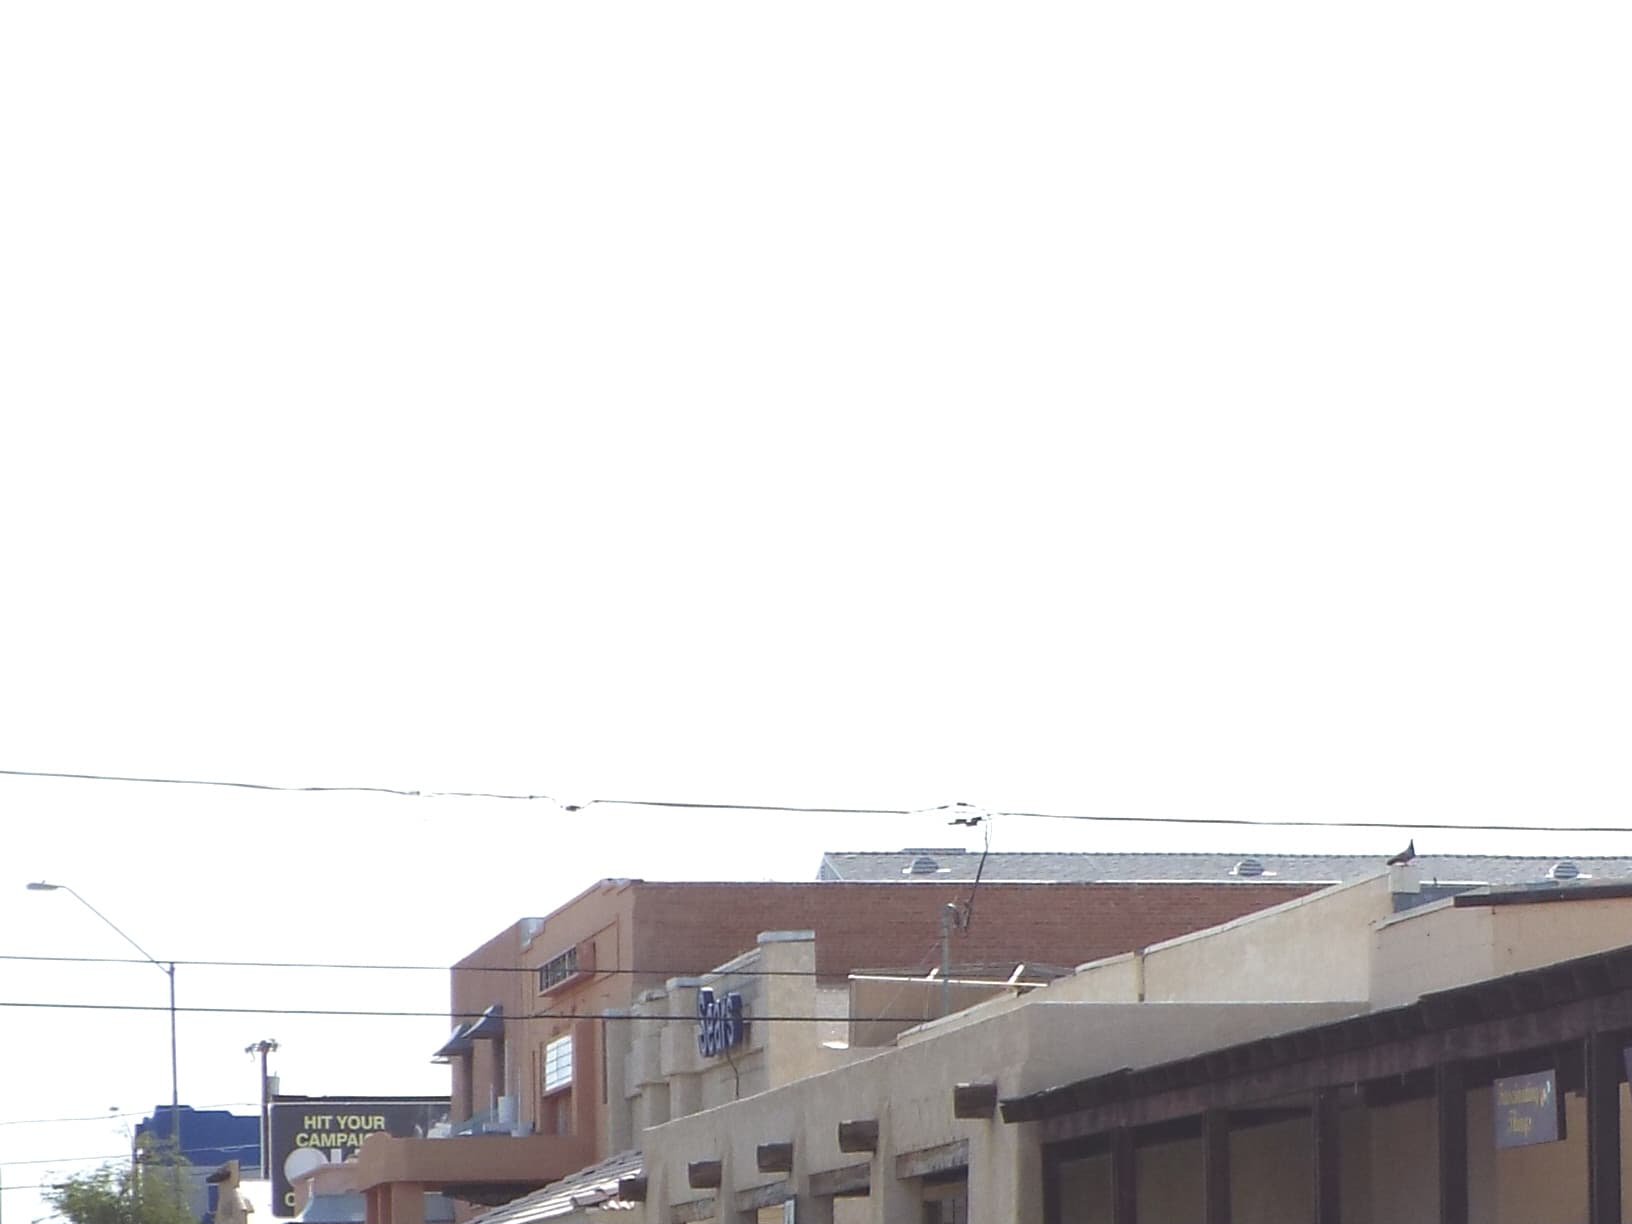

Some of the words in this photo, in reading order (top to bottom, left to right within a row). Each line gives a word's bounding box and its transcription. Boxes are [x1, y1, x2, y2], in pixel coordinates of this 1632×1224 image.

[698, 987, 743, 1057] Sears
[303, 1115, 333, 1130] HIT
[336, 1115, 386, 1130] YOUR
[295, 1133, 373, 1148] CAMPAI
